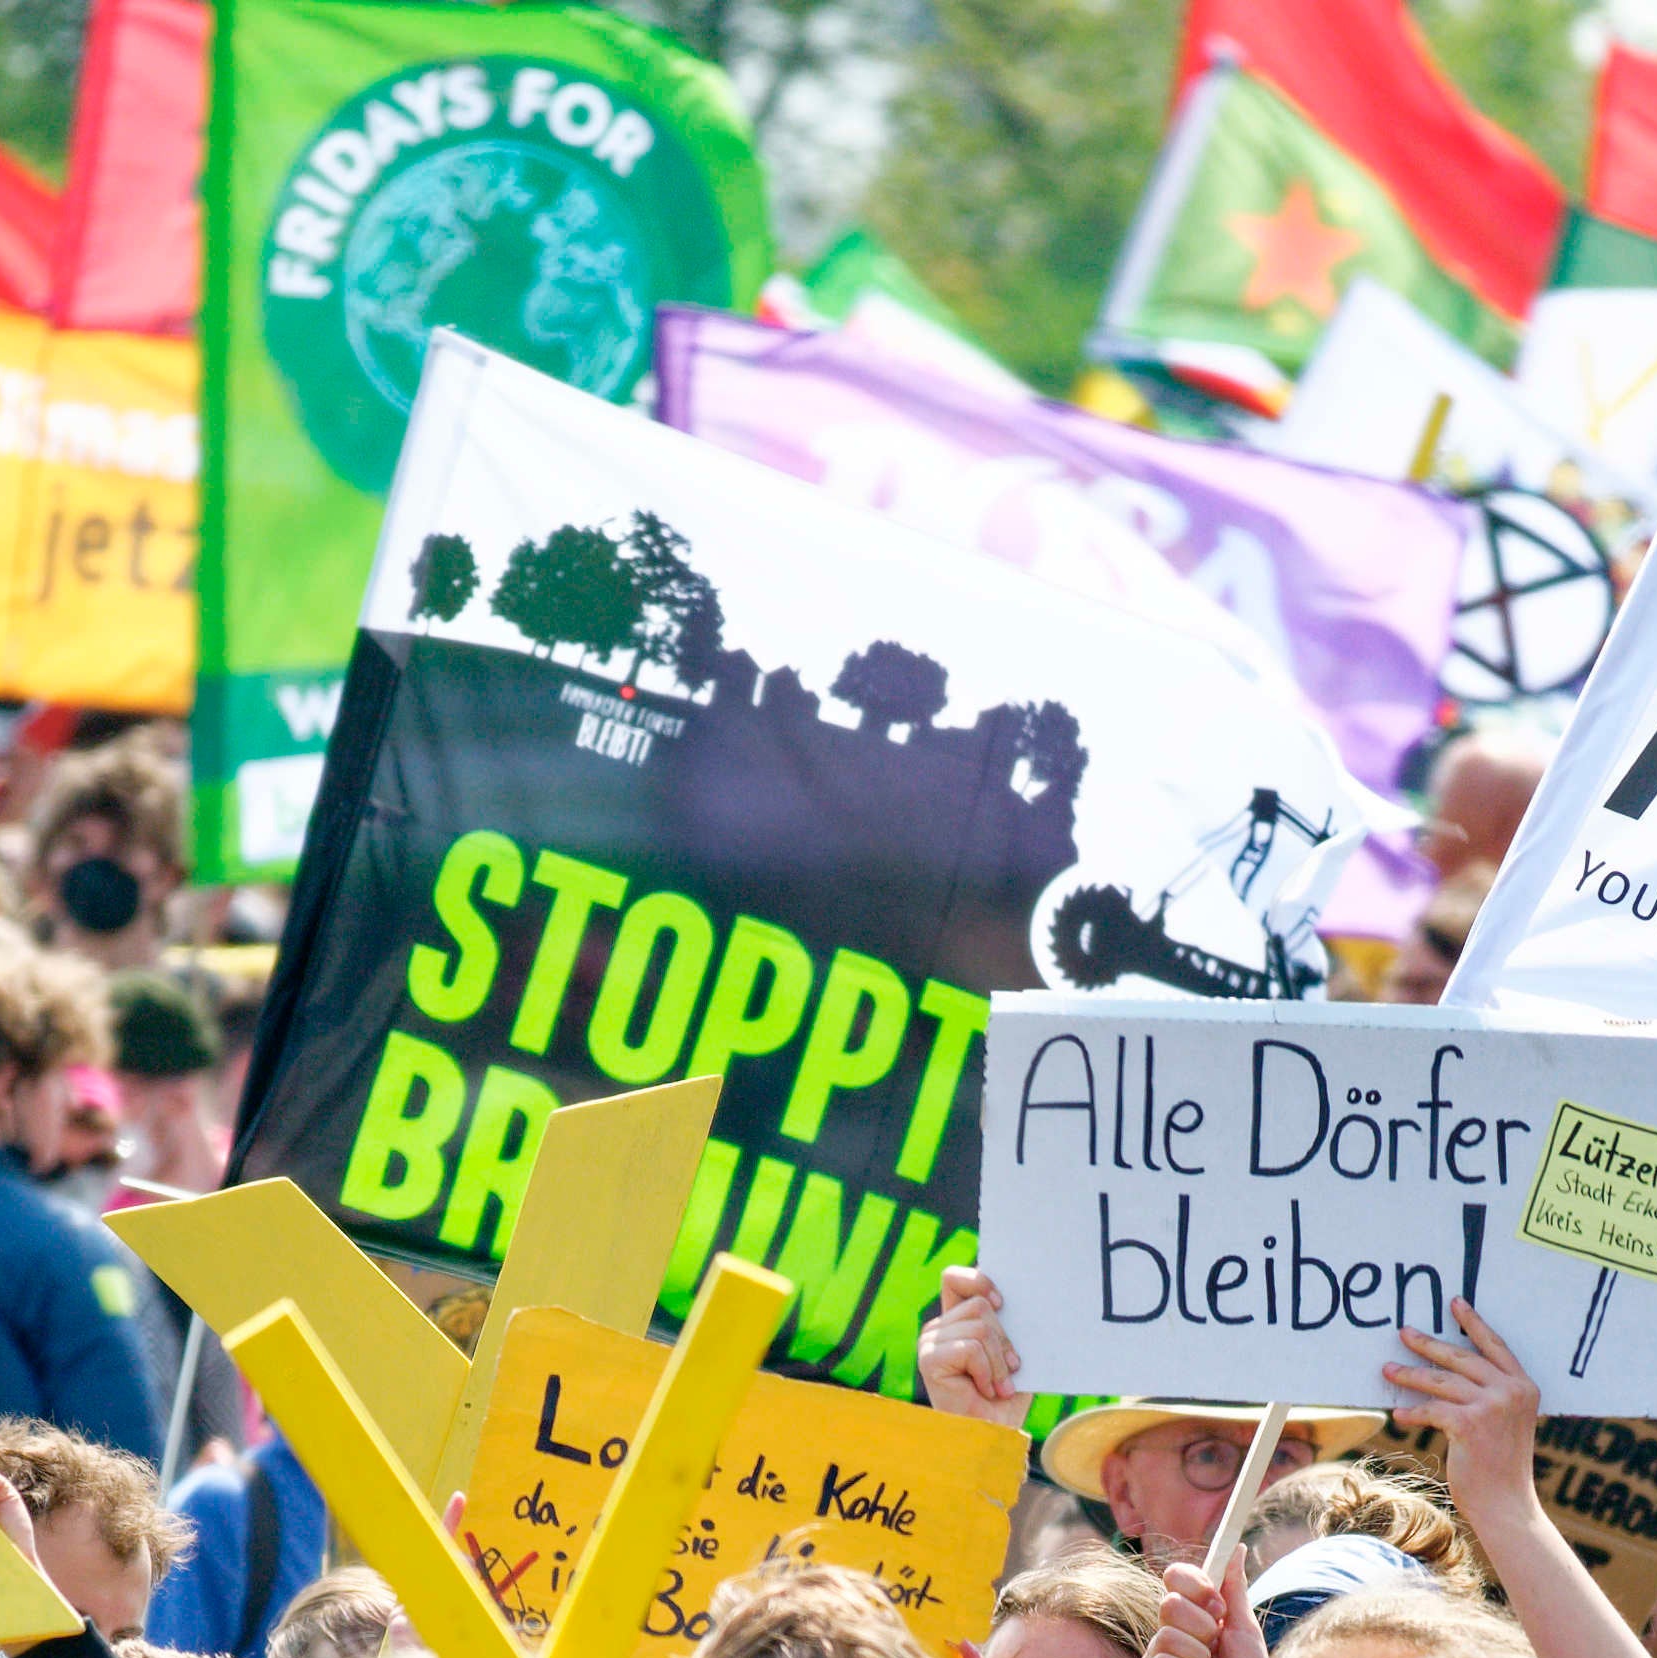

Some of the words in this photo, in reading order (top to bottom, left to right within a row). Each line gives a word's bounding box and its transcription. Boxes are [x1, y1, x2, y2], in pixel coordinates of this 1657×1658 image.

[270, 66, 497, 298] FRIDAYS
[507, 68, 654, 177] FOR
[407, 828, 990, 1184] STOPPT
[1017, 1034, 1205, 1175] Alle
[1250, 1039, 1530, 1184] Dörfer
[1536, 1197, 1583, 1235] Kreis
[1556, 1169, 1616, 1206] Stadt
[1100, 1194, 1487, 1336] bleiben!
[737, 1454, 787, 1502] die
